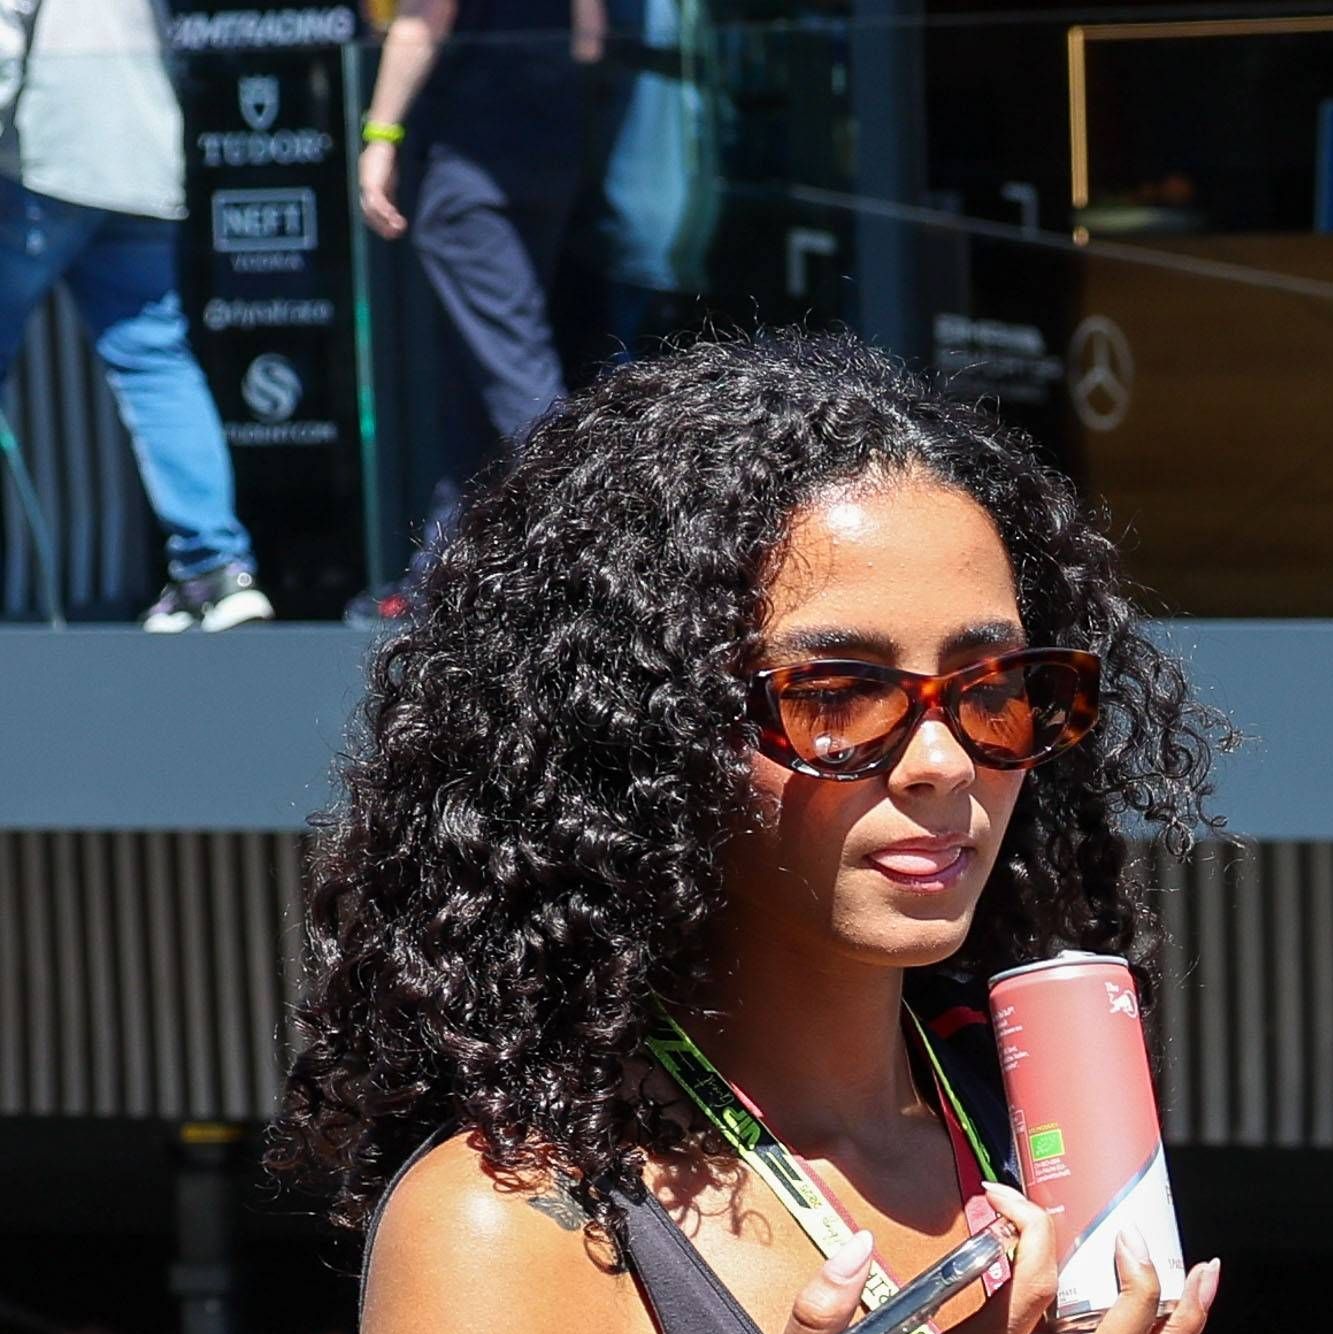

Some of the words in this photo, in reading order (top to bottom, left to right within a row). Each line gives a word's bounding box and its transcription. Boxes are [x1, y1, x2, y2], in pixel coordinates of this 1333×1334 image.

[197, 129, 331, 167] TUDOR
[222, 203, 302, 237] NEFT
[723, 1107, 761, 1149] VIP
